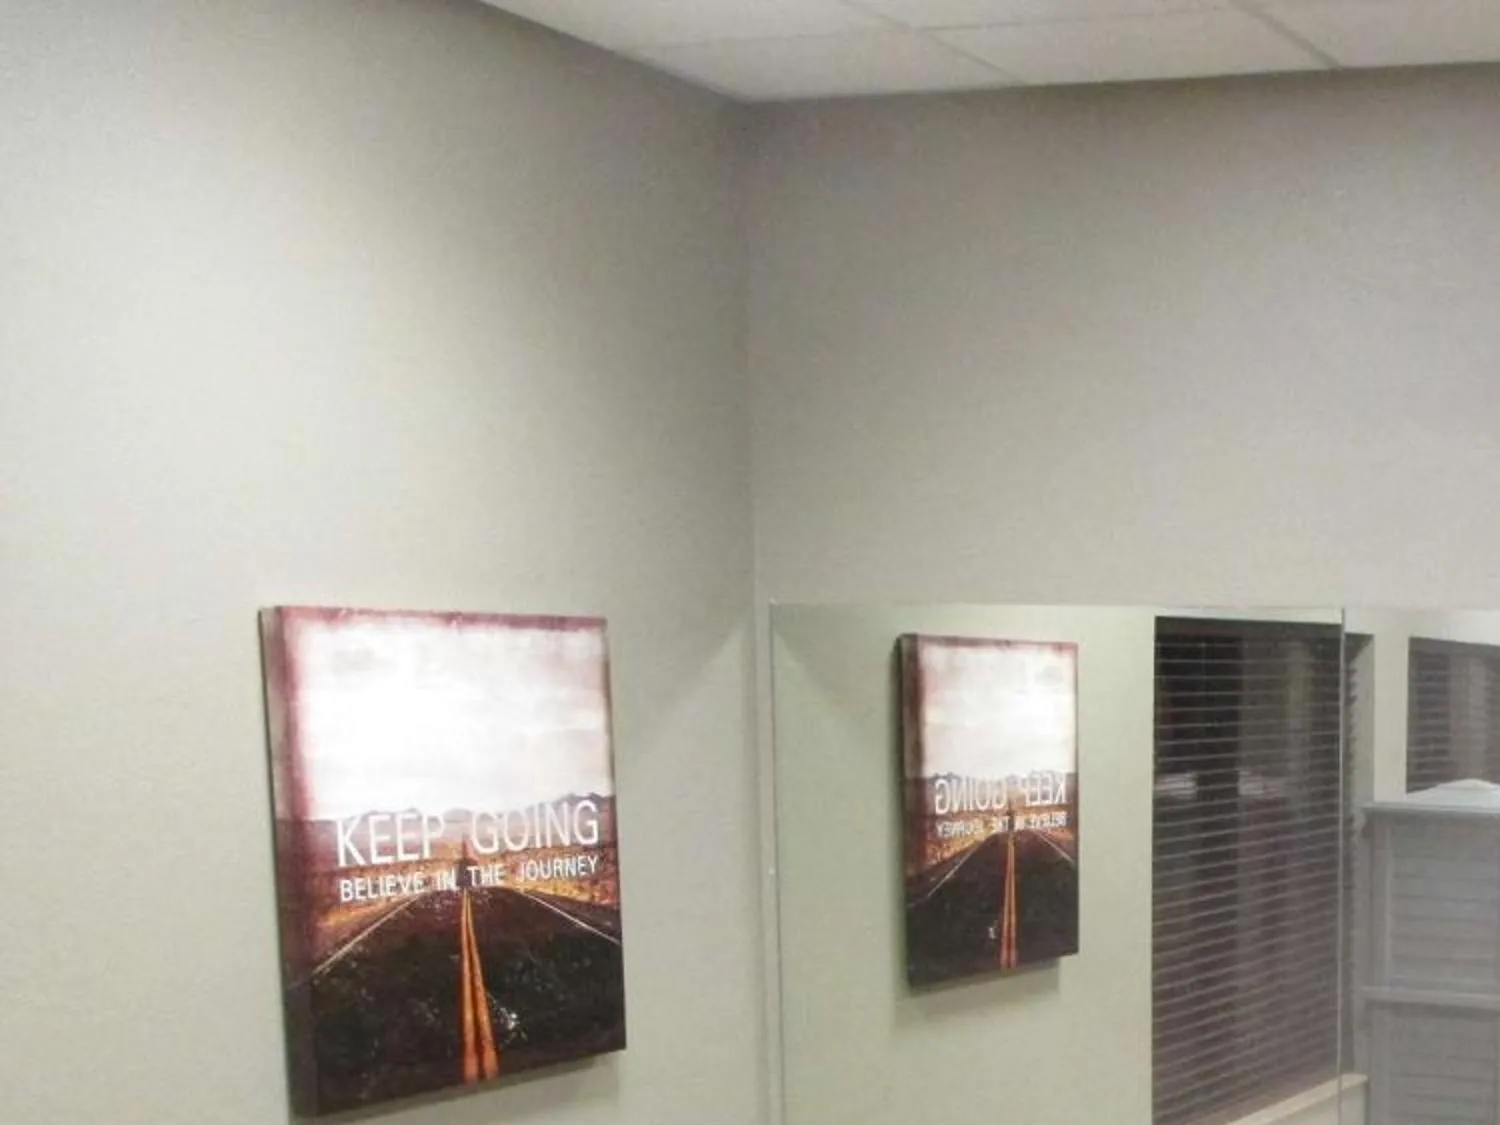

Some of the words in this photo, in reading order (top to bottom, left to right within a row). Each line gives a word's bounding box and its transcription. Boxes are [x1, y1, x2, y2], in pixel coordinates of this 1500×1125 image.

[336, 812, 445, 868] KEEP
[471, 799, 599, 854] GOING
[340, 871, 427, 902] BELIEVE
[432, 869, 458, 891] IN
[468, 863, 507, 888] THE
[518, 855, 599, 882] JOURNEY
